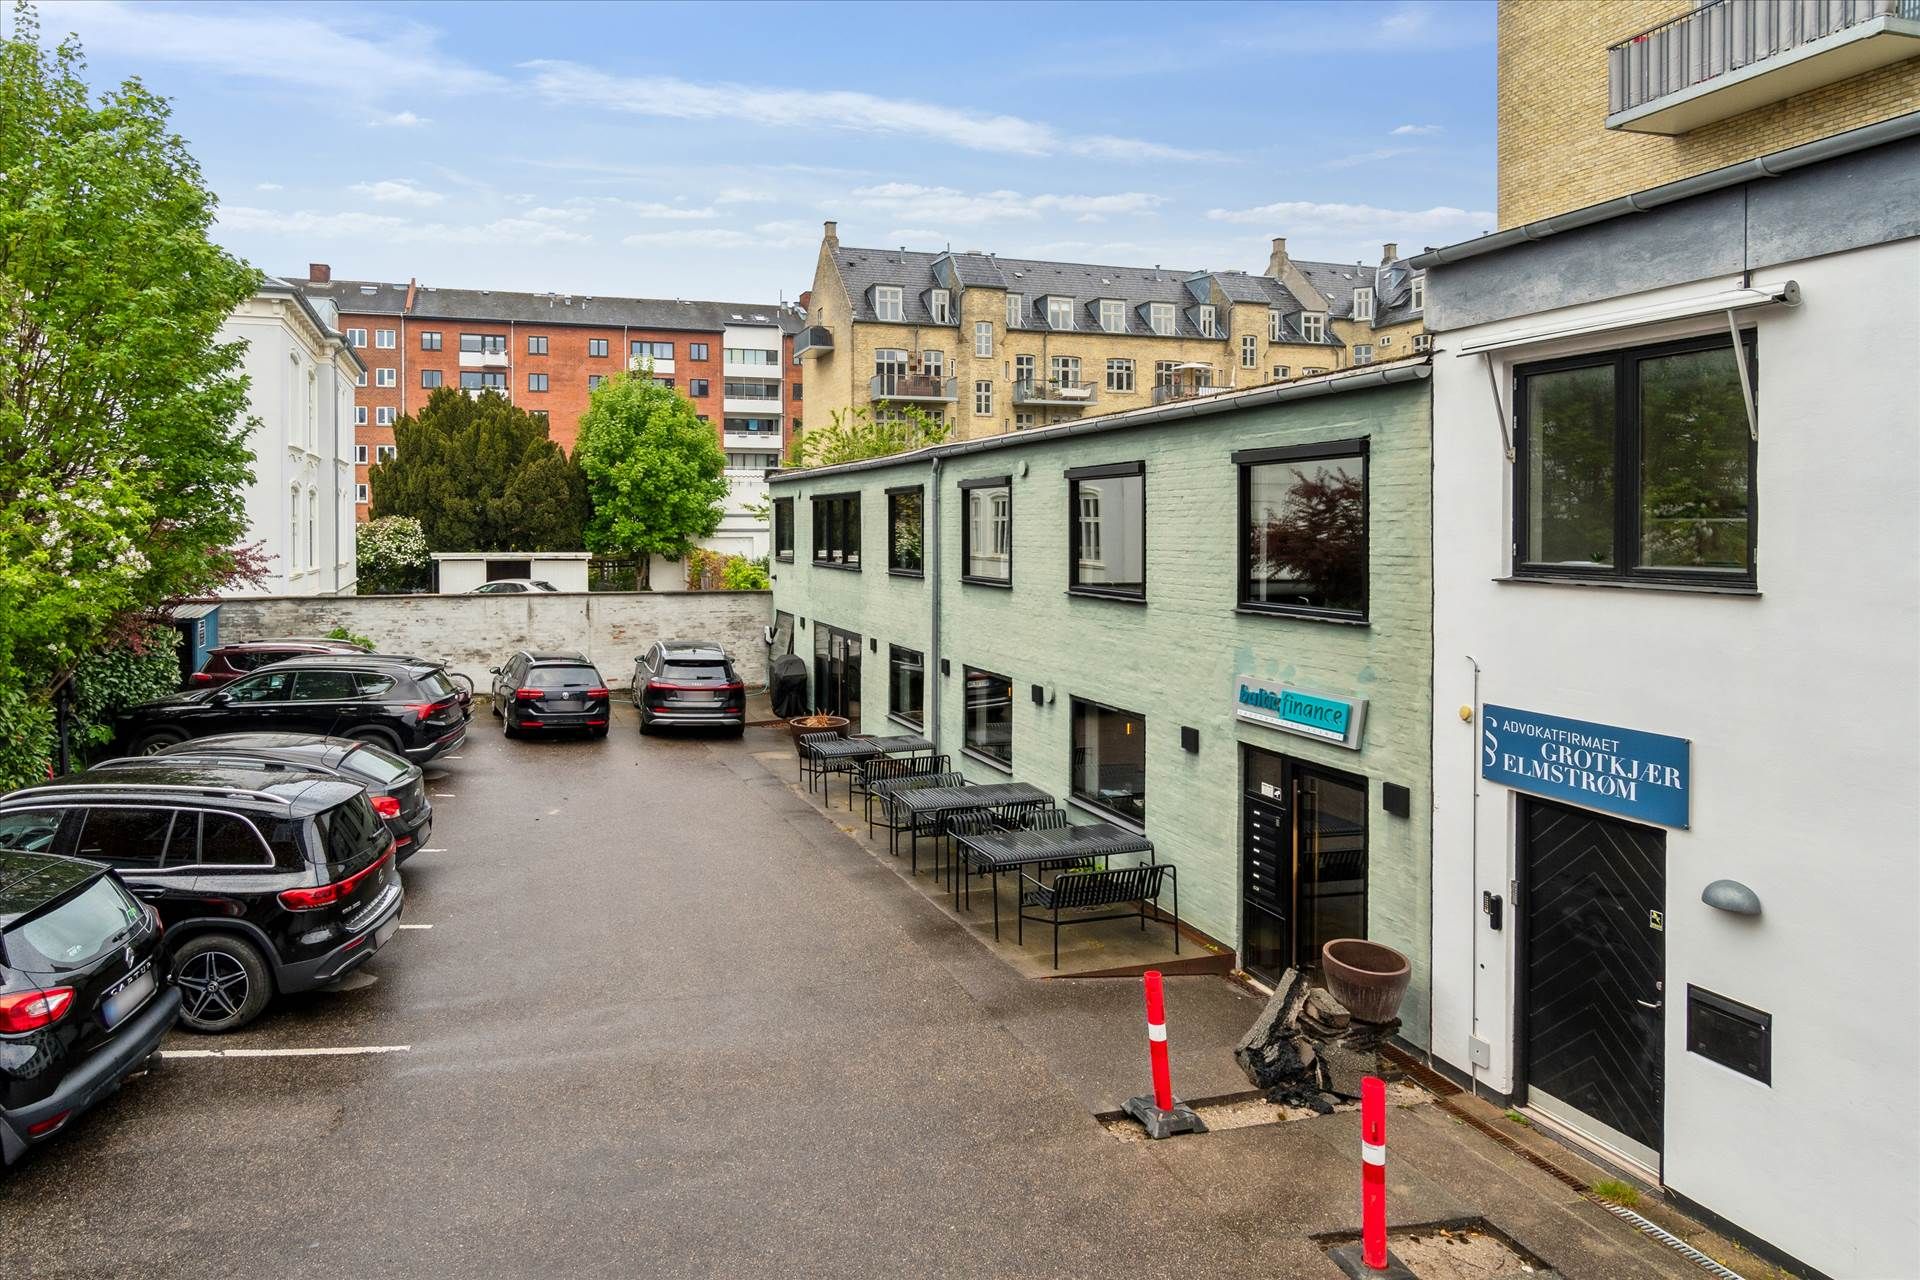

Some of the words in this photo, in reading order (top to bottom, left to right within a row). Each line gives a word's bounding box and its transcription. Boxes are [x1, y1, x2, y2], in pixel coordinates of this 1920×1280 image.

[1282, 693, 1343, 725] finance
[1503, 720, 1620, 753] ADVOKATFIRMAET
[1503, 753, 1638, 802] ELMSTRØM
[1541, 742, 1683, 790] GROTKJÆR
[110, 961, 152, 996] CAPTUR
